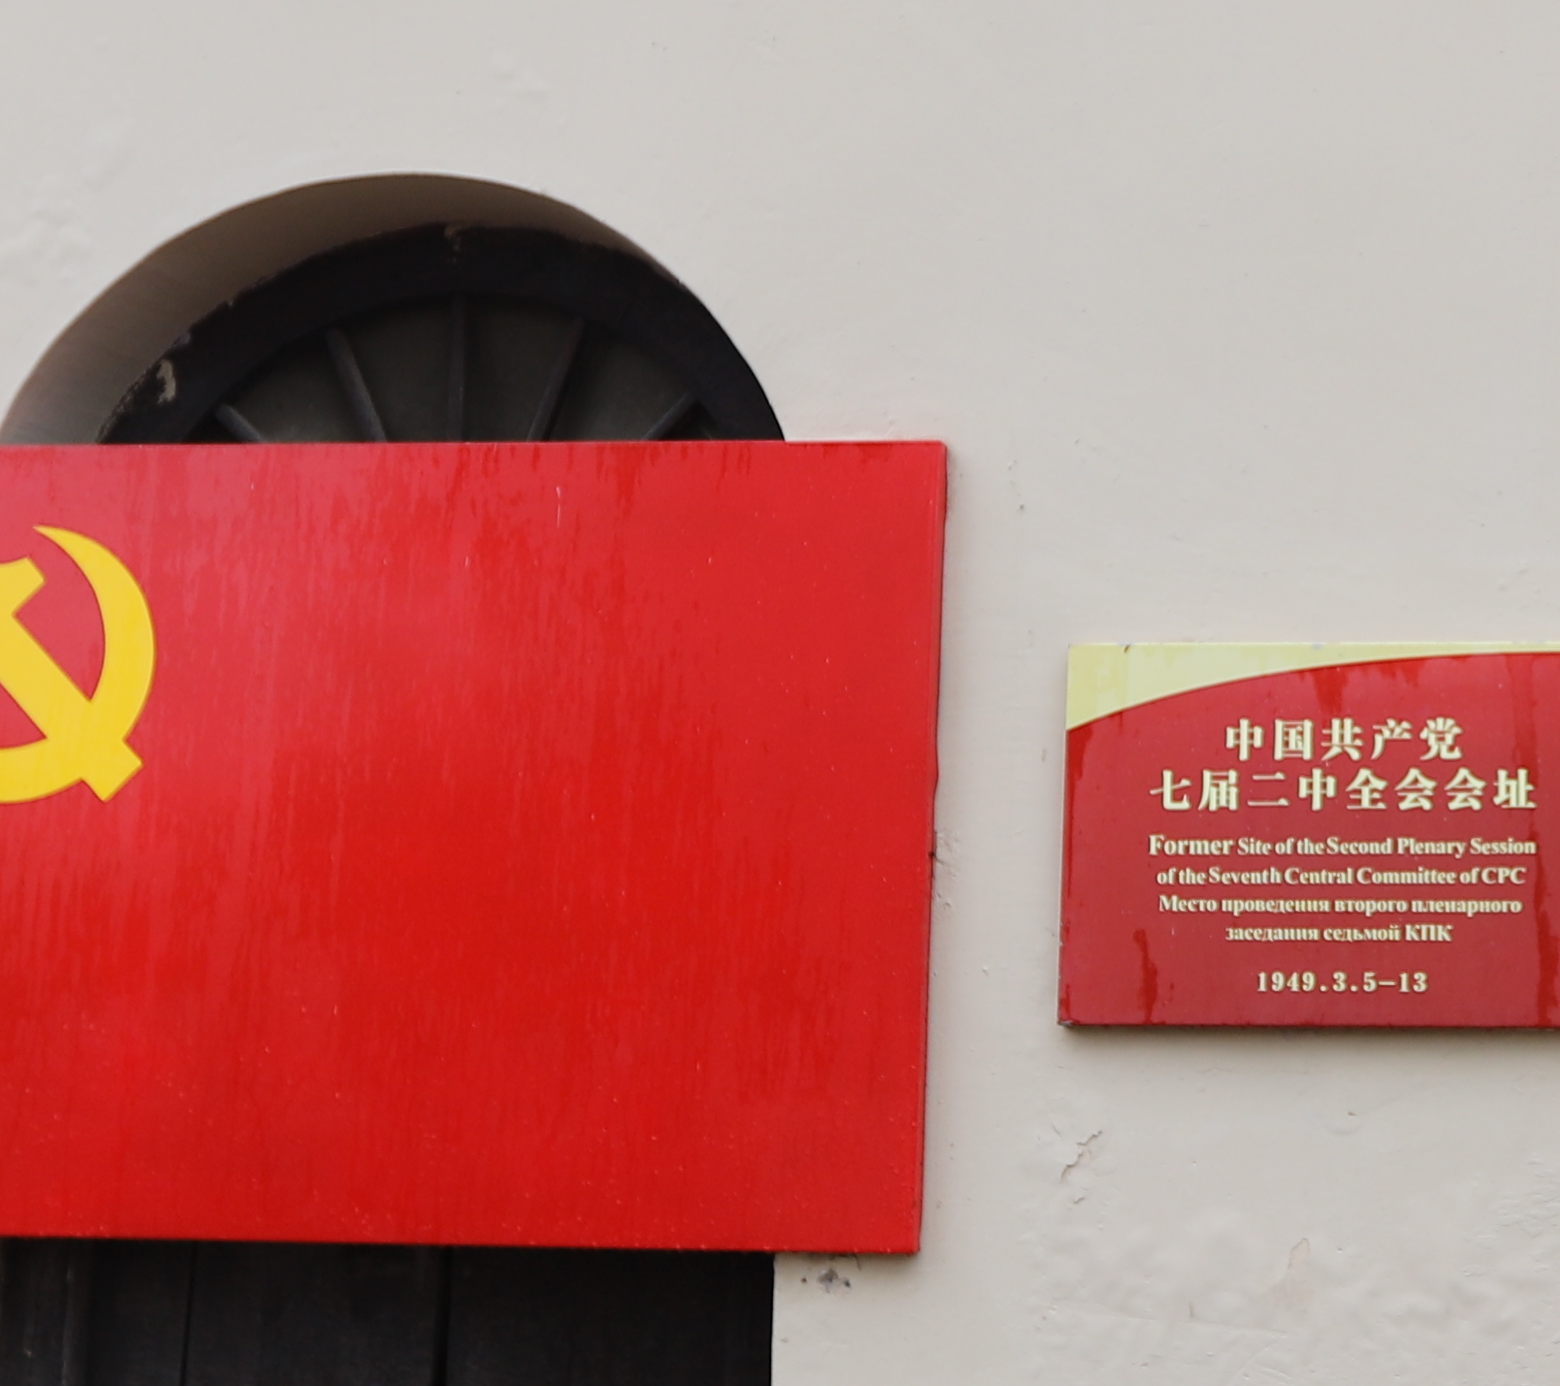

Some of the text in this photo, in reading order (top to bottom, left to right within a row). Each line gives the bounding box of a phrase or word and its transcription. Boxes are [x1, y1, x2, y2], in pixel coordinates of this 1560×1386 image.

[1225, 716, 1464, 762] 中国共产党
[1149, 767, 1537, 812] 七届二中全会会址
[1149, 834, 1537, 859] Former Site of the Second Plenary Session
[1156, 865, 1527, 885] of the Seventh Central Committee of CPC
[1159, 894, 1523, 918] Место проведения второго пленарного
[1225, 924, 1456, 943] заседания седьмой КПК
